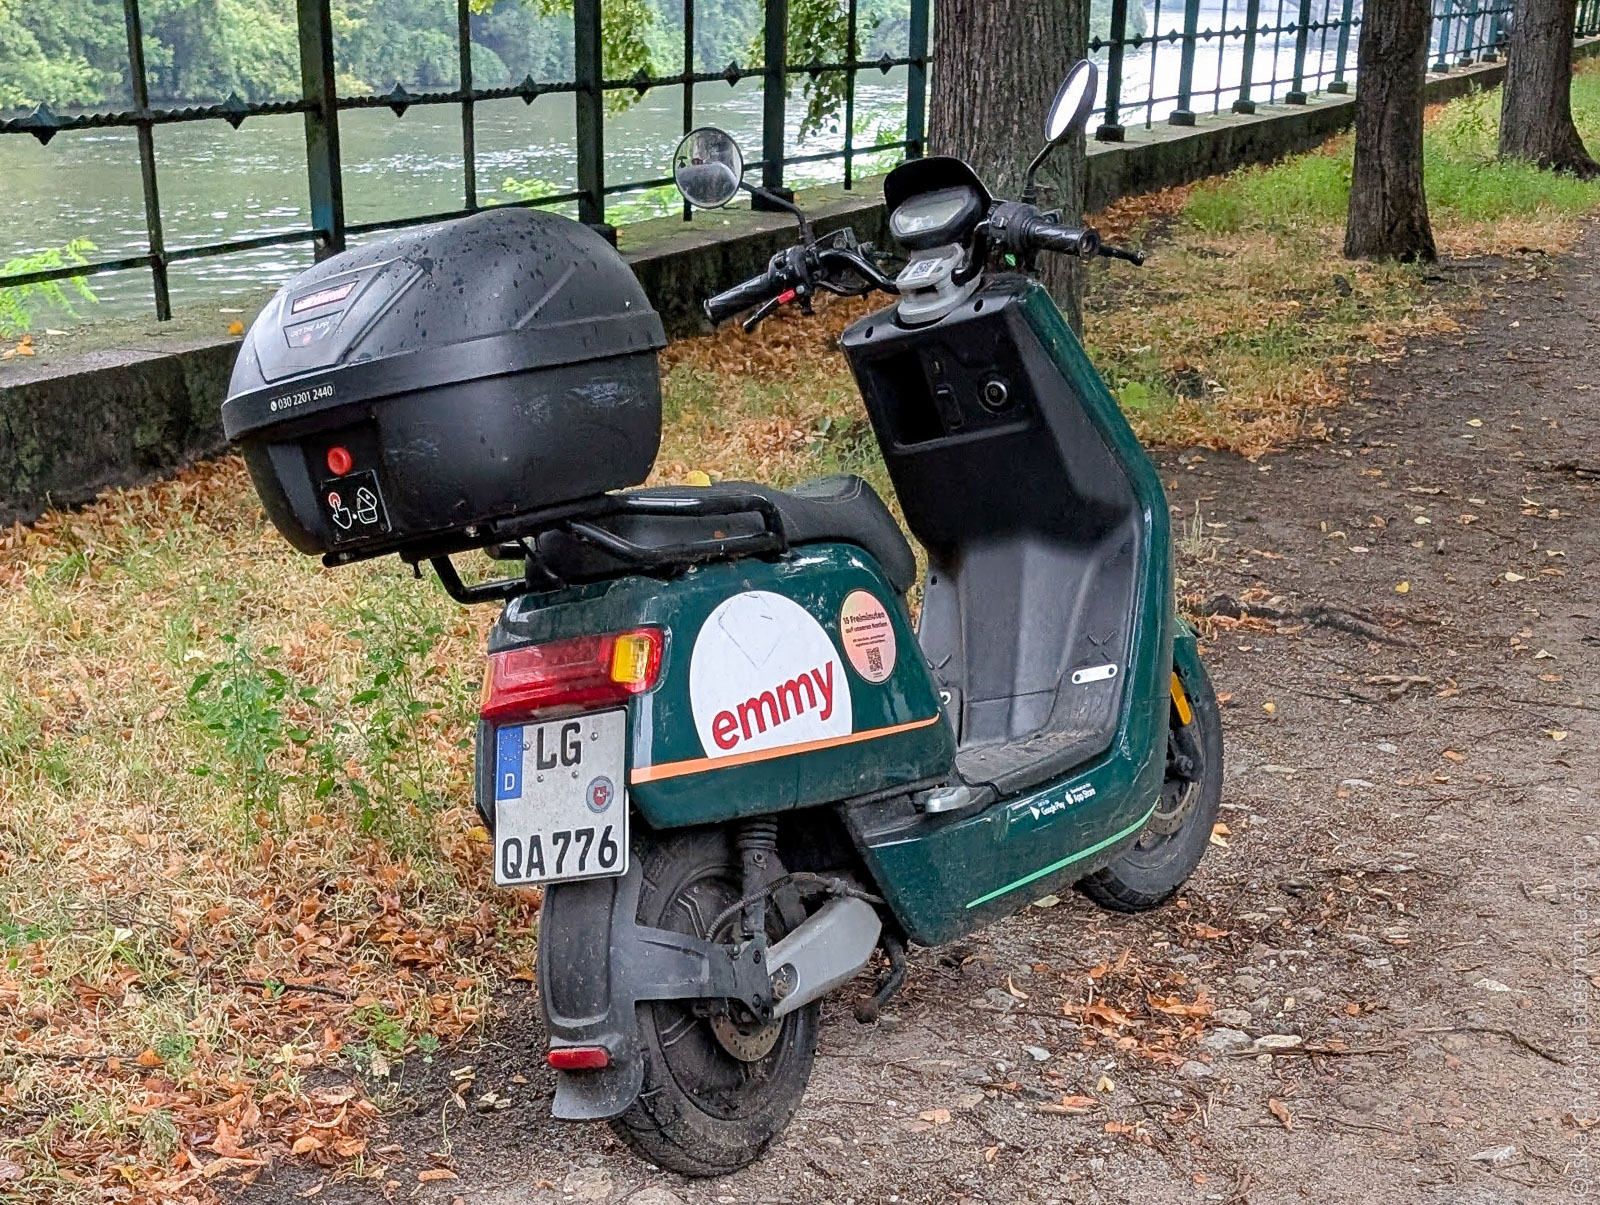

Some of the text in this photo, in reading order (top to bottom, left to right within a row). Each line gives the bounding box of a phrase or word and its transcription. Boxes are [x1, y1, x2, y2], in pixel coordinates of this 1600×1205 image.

[277, 385, 333, 410] 030 2201 2440
[849, 611, 885, 623] Freiminuten
[711, 660, 834, 751] emmy
[536, 722, 582, 771] LG
[504, 773, 515, 792] D
